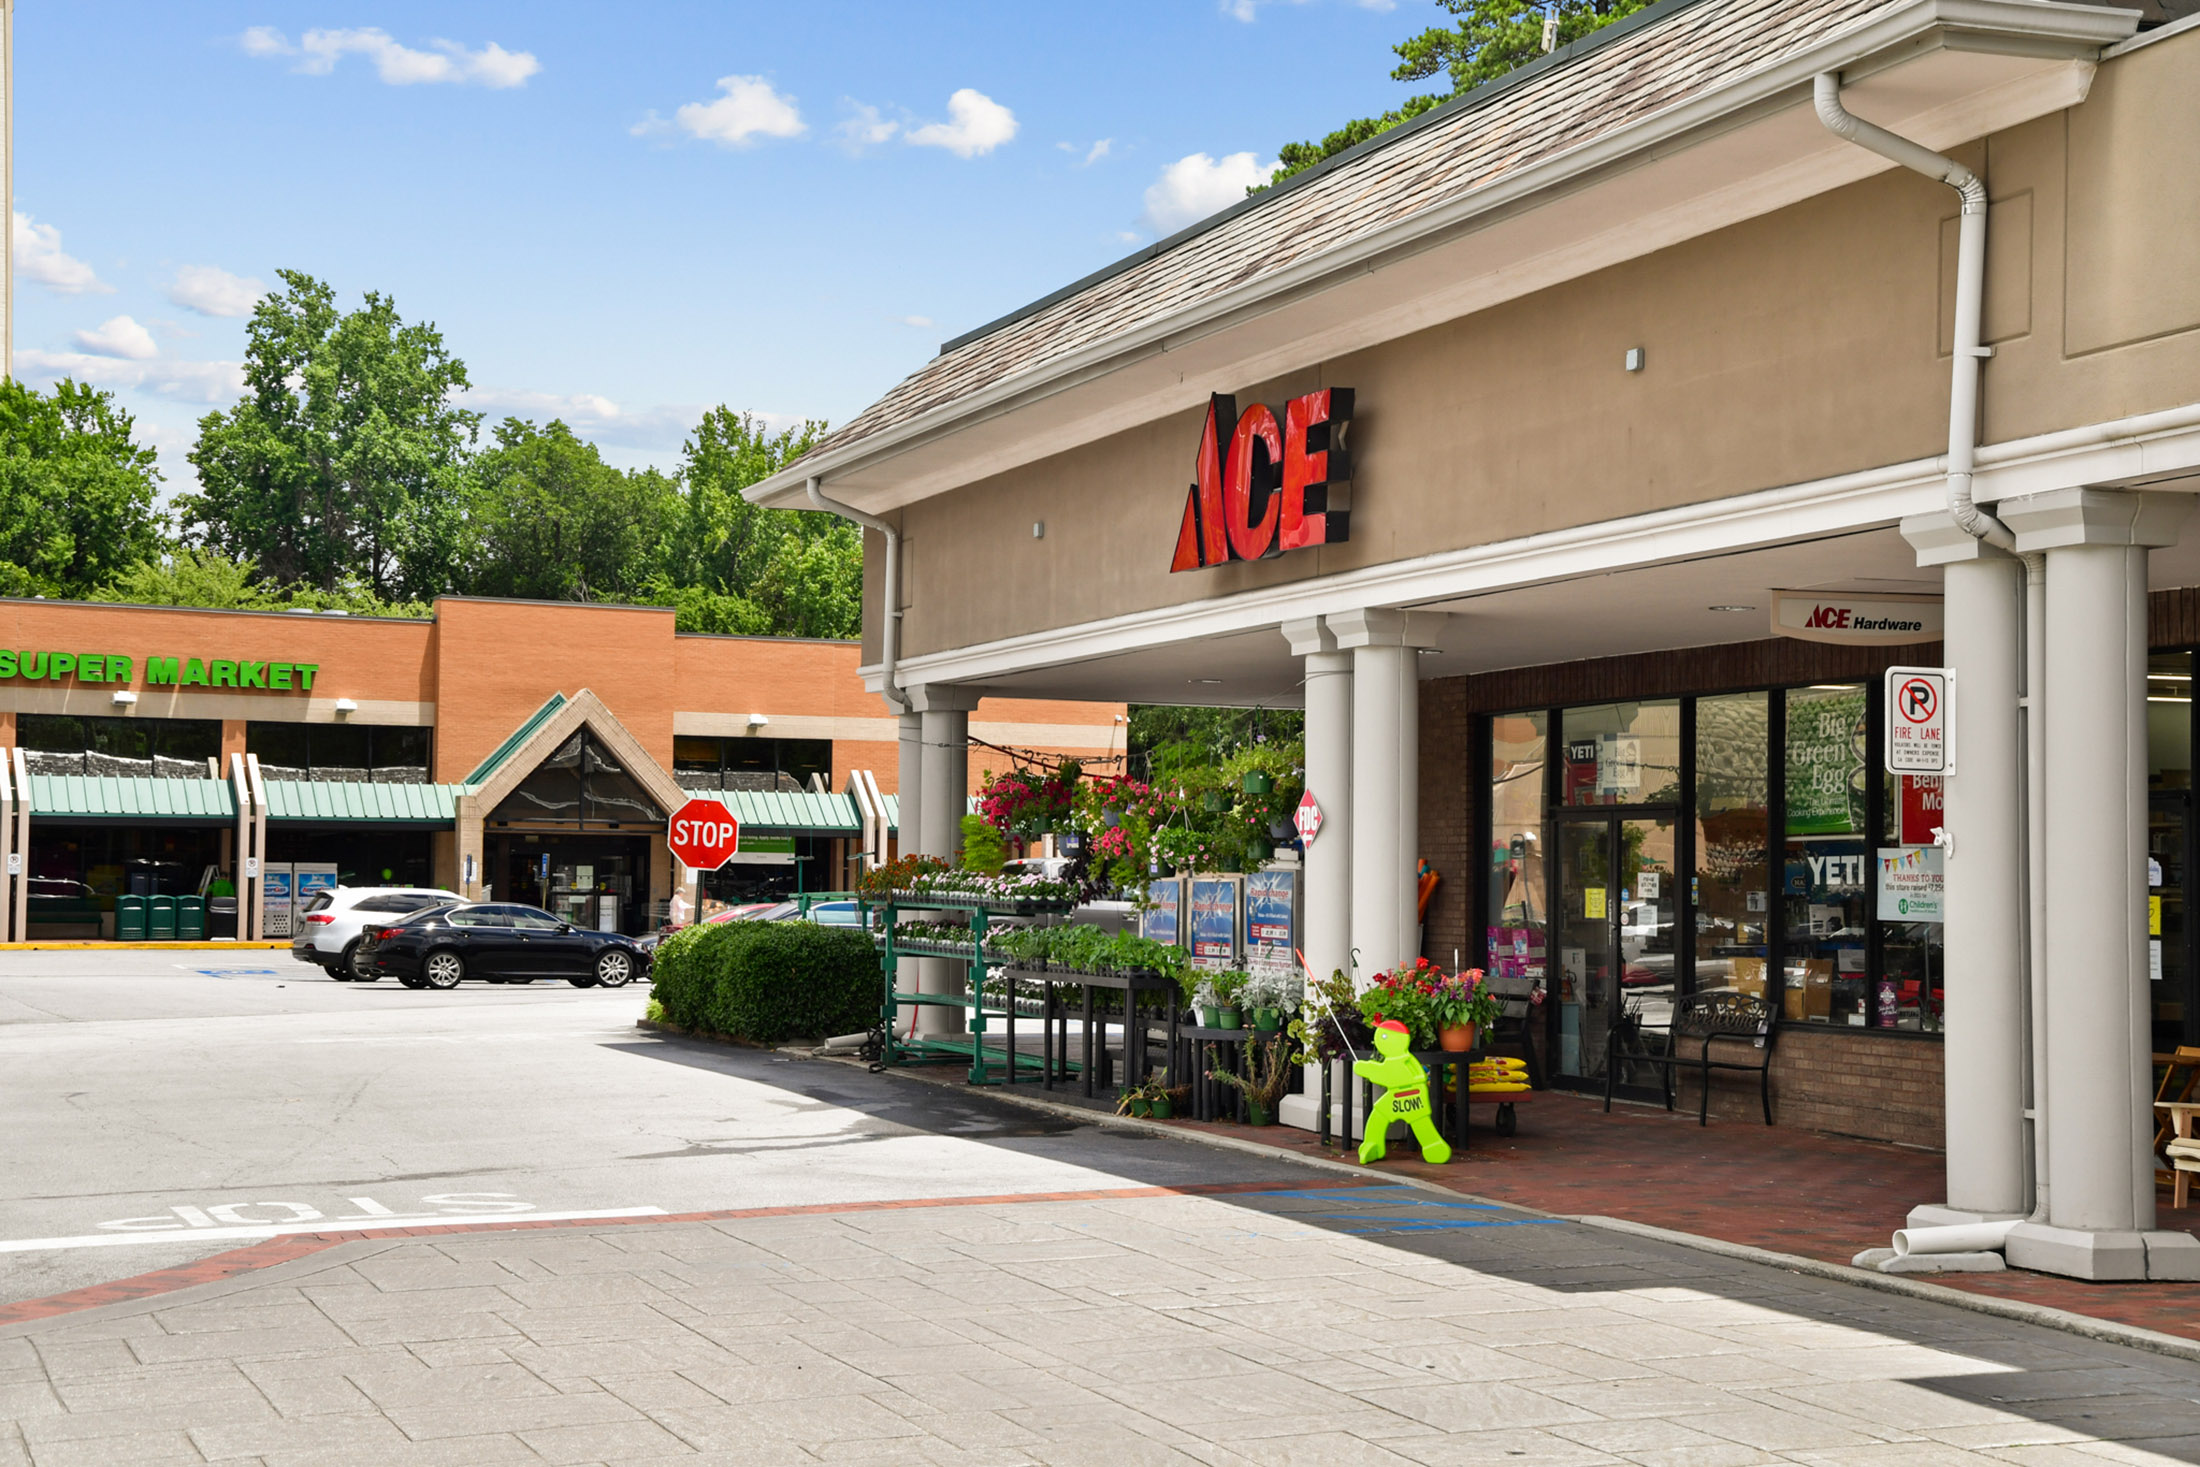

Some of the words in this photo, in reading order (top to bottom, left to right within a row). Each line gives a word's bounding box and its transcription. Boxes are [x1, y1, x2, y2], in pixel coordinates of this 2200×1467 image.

[1170, 388, 1352, 573] ACE
[1805, 603, 1851, 629] ACE
[1853, 616, 1922, 632] Hardware
[0, 649, 133, 683] SUPER
[147, 656, 319, 690] MARKET
[1818, 712, 1846, 742] Big
[1894, 726, 1912, 740] FIRE
[1919, 727, 1941, 741] LANE
[1570, 744, 1594, 760] YETI
[1791, 740, 1846, 766] Green
[1812, 765, 1846, 795] Egg
[1299, 806, 1318, 831] FDC
[1787, 808, 1811, 819] Cooking
[674, 819, 734, 848] STOP
[1807, 855, 1865, 885] YETI
[1893, 873, 1920, 883] THANKS
[1921, 874, 1930, 883] TO
[1930, 874, 1944, 883] YOU
[1909, 900, 1937, 909] Children's
[1392, 1096, 1424, 1113] SLOW!
[98, 1192, 536, 1230] STOP
